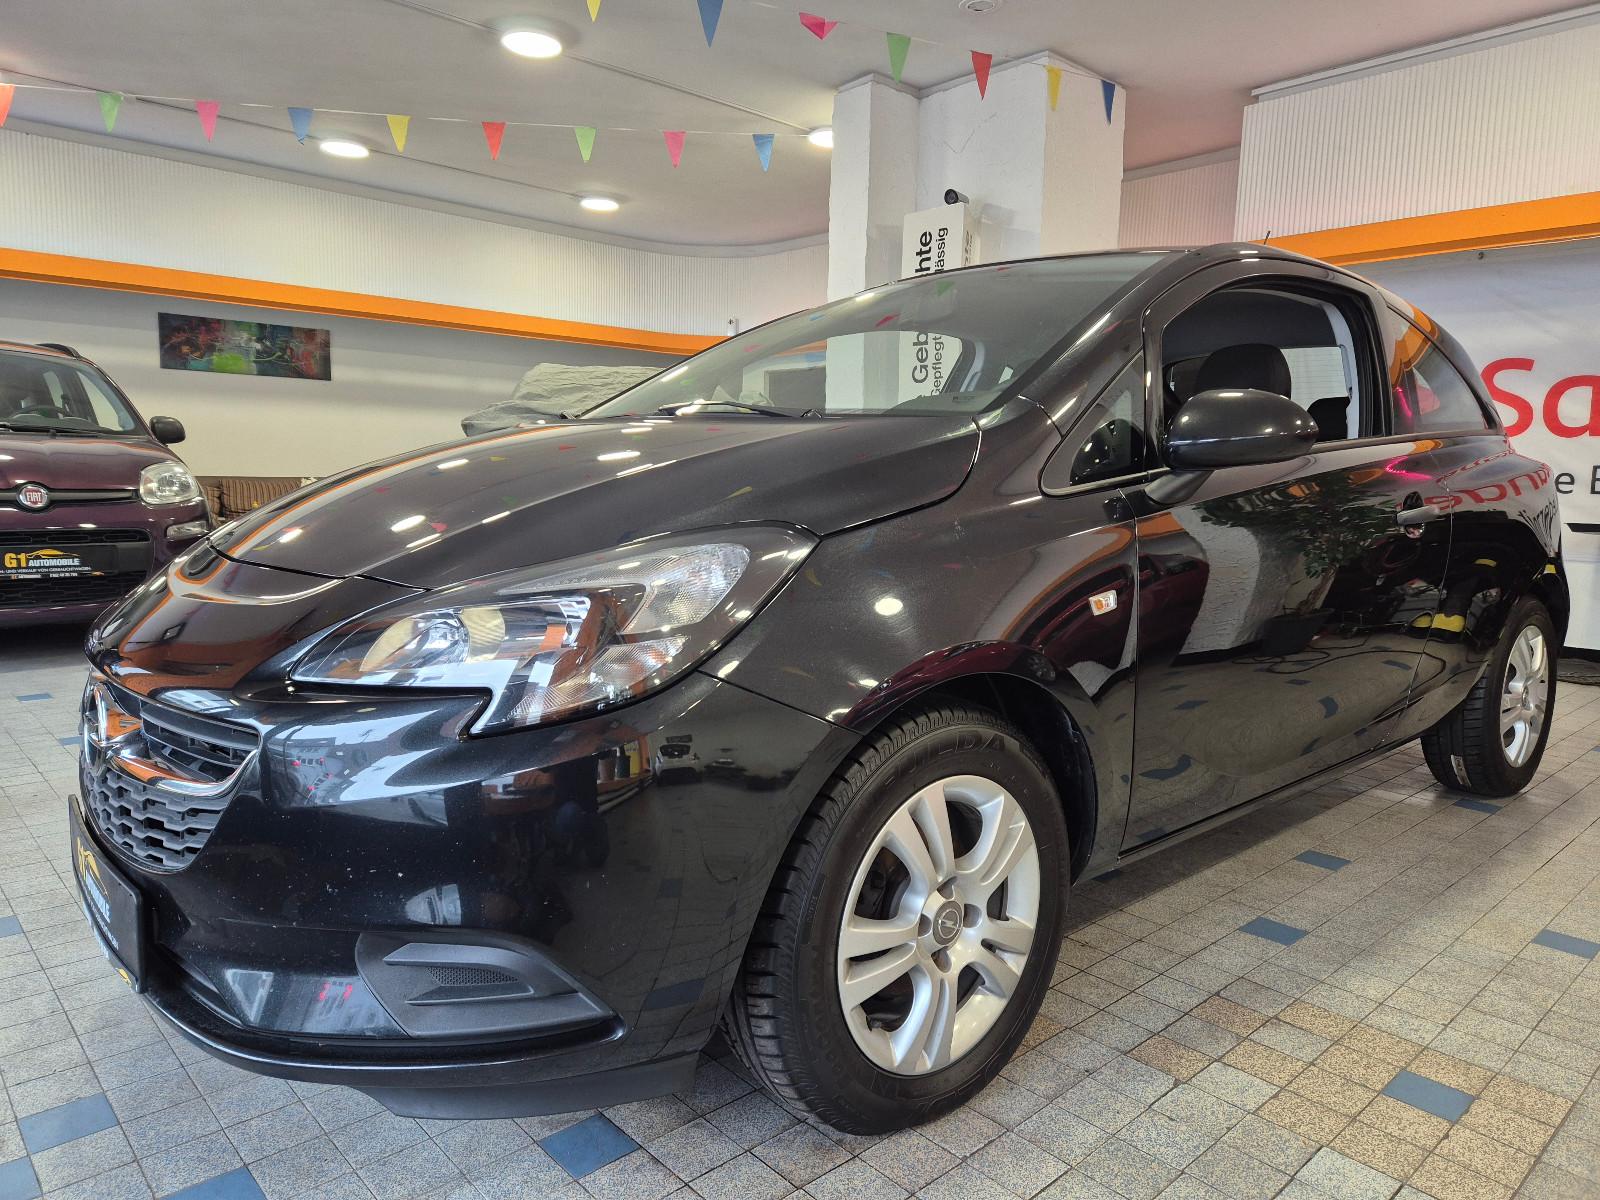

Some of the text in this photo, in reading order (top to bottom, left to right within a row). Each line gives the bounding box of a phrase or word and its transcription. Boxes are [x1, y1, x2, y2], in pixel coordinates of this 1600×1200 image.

[26, 492, 42, 502] FIAT
[4, 552, 27, 568] G1
[28, 558, 80, 567] AUTOMOBILE
